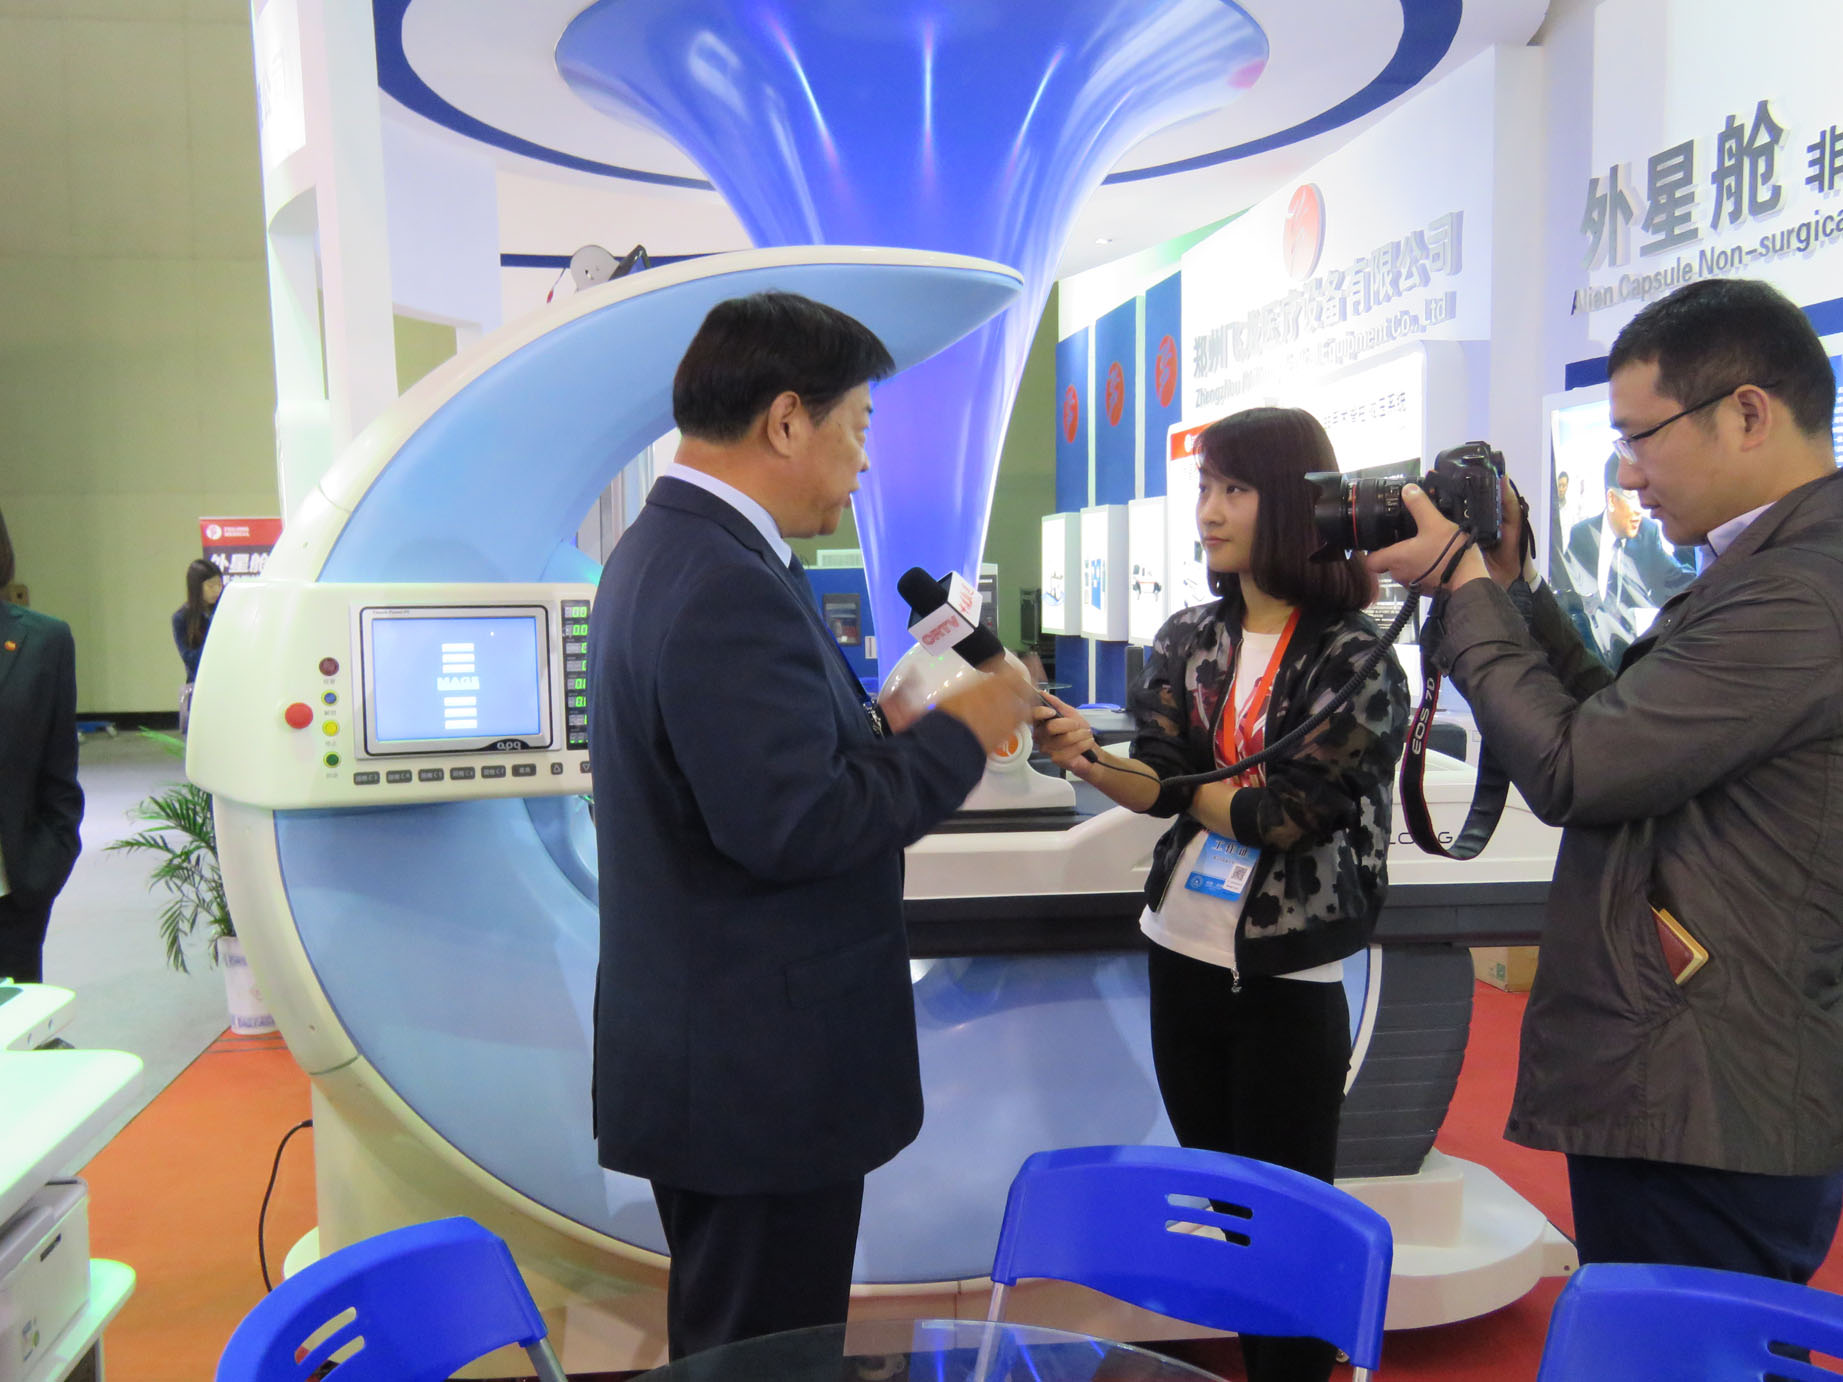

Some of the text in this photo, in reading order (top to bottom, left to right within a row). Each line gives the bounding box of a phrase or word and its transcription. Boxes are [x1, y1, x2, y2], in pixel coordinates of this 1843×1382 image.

[1581, 99, 1784, 272] 外星舱
[1618, 256, 1693, 302] Capsule
[1411, 677, 1437, 755] EOS 7D
[1389, 831, 1454, 845] OG
